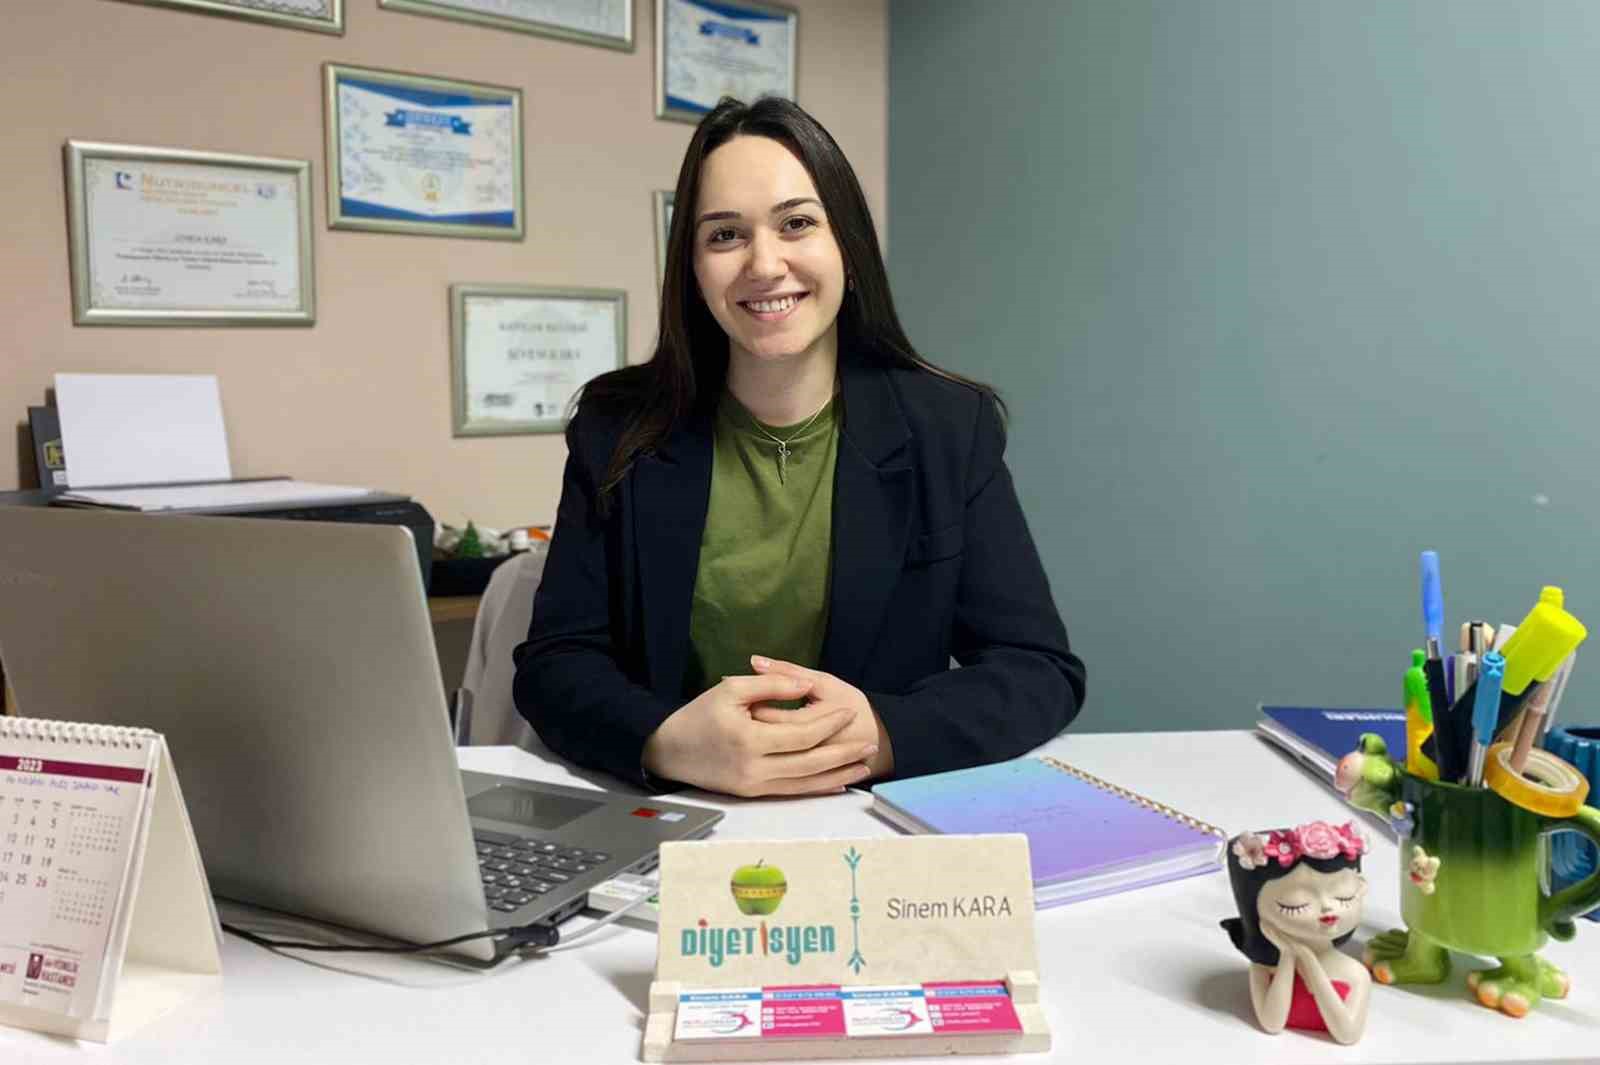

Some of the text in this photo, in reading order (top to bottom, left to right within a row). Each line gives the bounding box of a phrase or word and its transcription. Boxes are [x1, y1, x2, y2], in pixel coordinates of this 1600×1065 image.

[16, 758, 43, 772] 2023
[886, 895, 1012, 920] Sinem KARA
